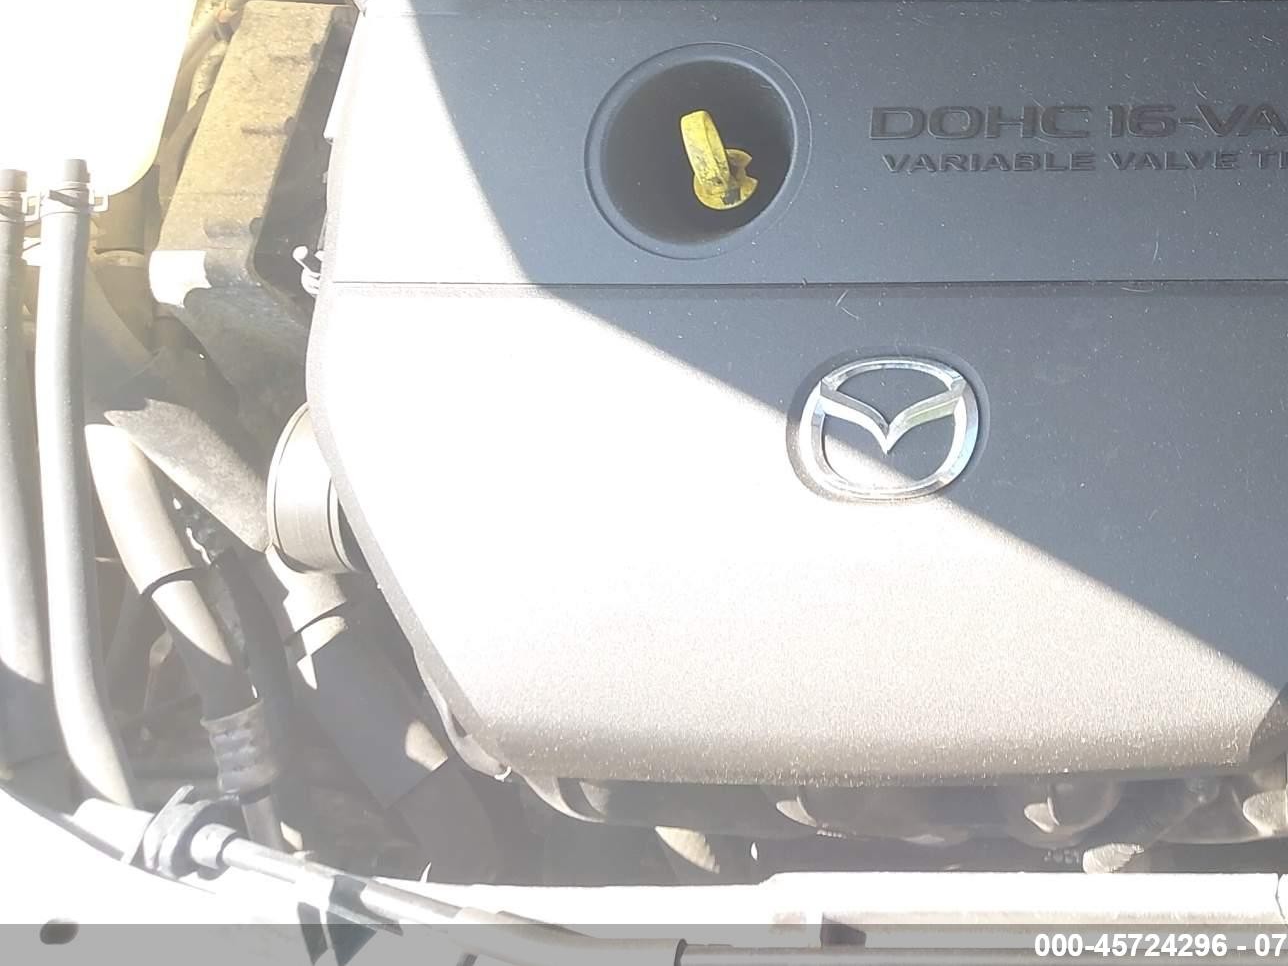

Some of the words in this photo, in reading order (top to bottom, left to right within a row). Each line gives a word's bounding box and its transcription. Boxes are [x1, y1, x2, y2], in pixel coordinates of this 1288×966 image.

[869, 106, 1092, 140] DOHC
[881, 152, 1096, 173] VARIABLE
[1107, 150, 1241, 171] VALVE
